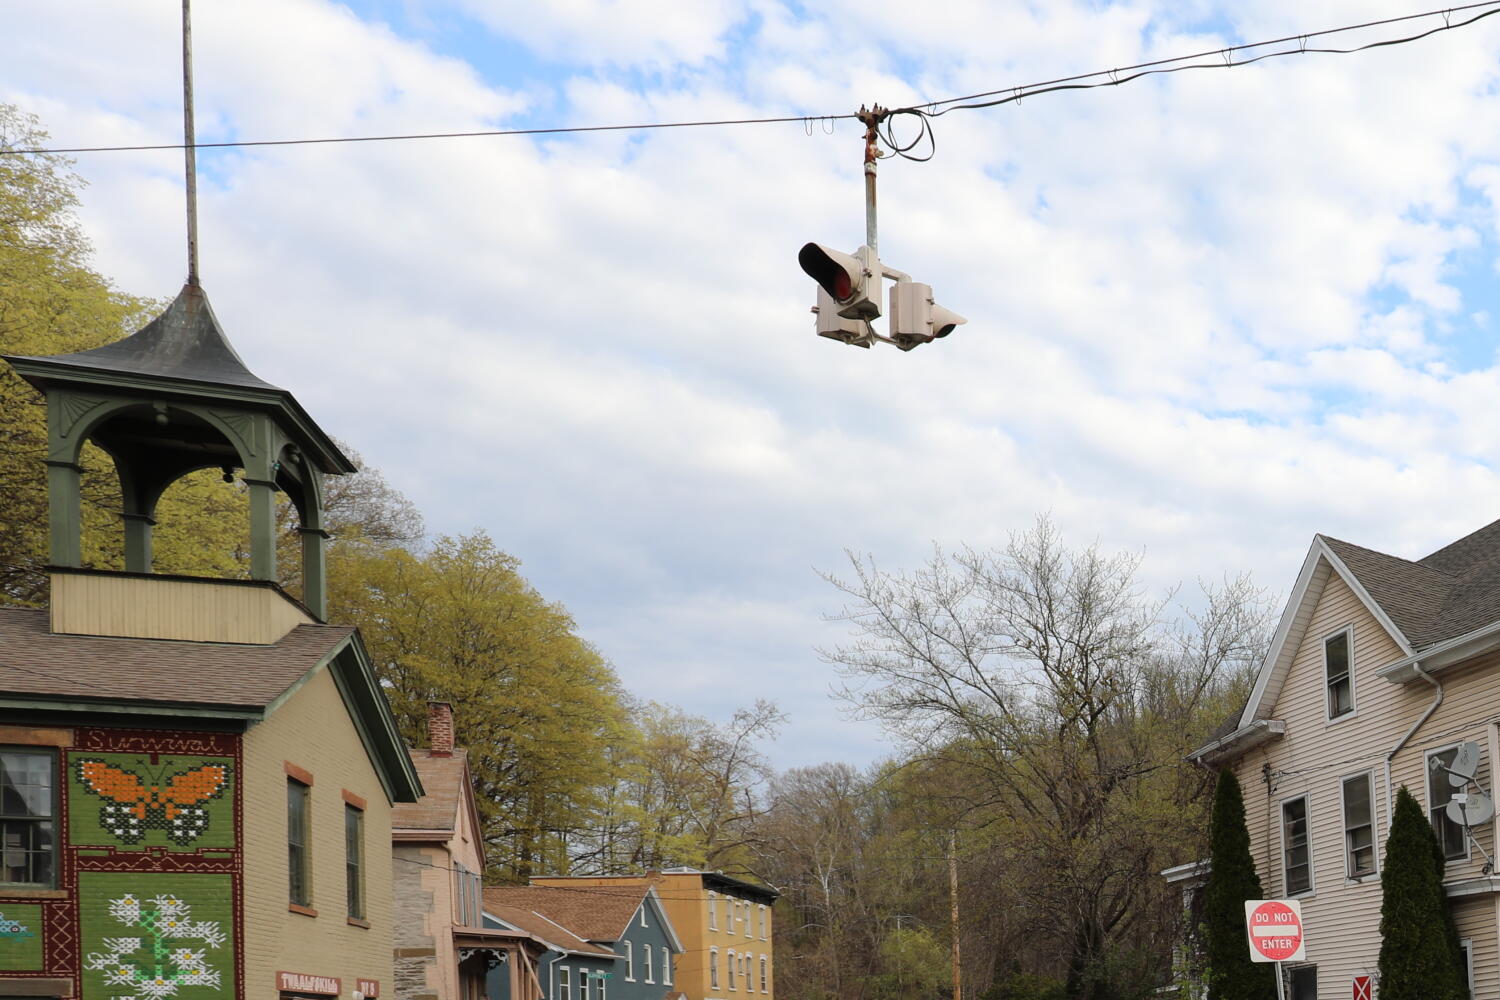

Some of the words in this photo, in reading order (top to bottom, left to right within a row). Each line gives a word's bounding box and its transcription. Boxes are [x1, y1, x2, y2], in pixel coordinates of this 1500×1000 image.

[88, 730, 224, 752] Survival
[1255, 912, 1269, 923] DO
[1274, 912, 1293, 922] NOT
[1262, 939, 1293, 949] ENTER
